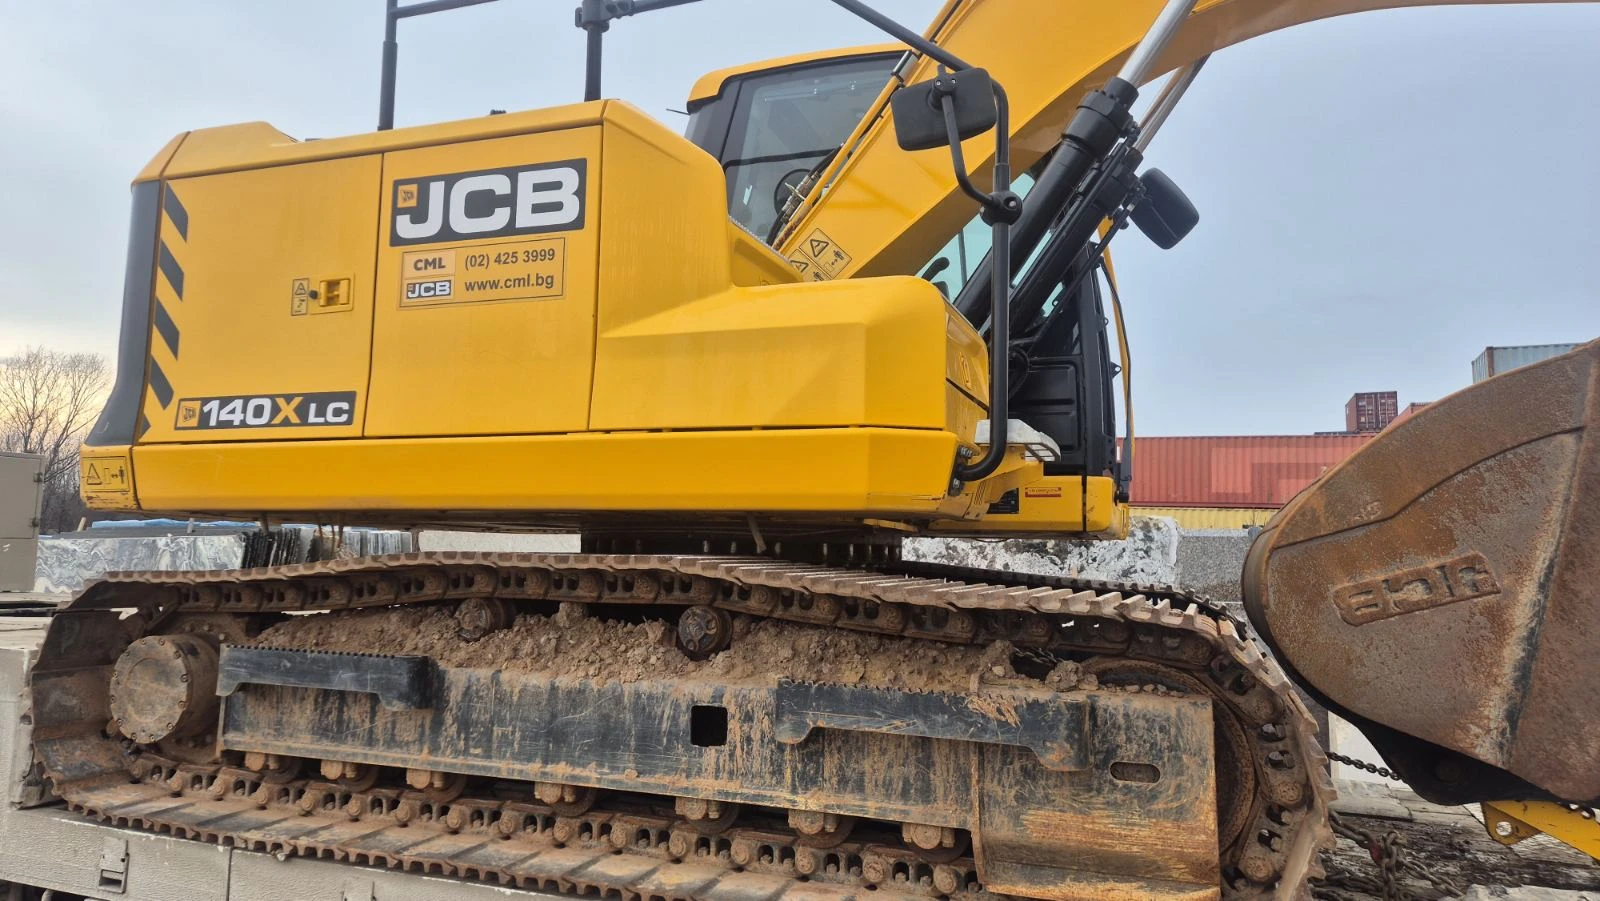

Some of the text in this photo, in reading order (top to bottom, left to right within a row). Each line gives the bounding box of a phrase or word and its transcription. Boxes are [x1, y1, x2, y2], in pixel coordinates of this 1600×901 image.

[395, 167, 580, 239] JCB
[413, 257, 446, 271] CML
[464, 248, 556, 271] (02) 425 3999
[407, 281, 451, 298] JCB
[464, 273, 555, 291] www.cml.bg
[307, 402, 350, 424] LC
